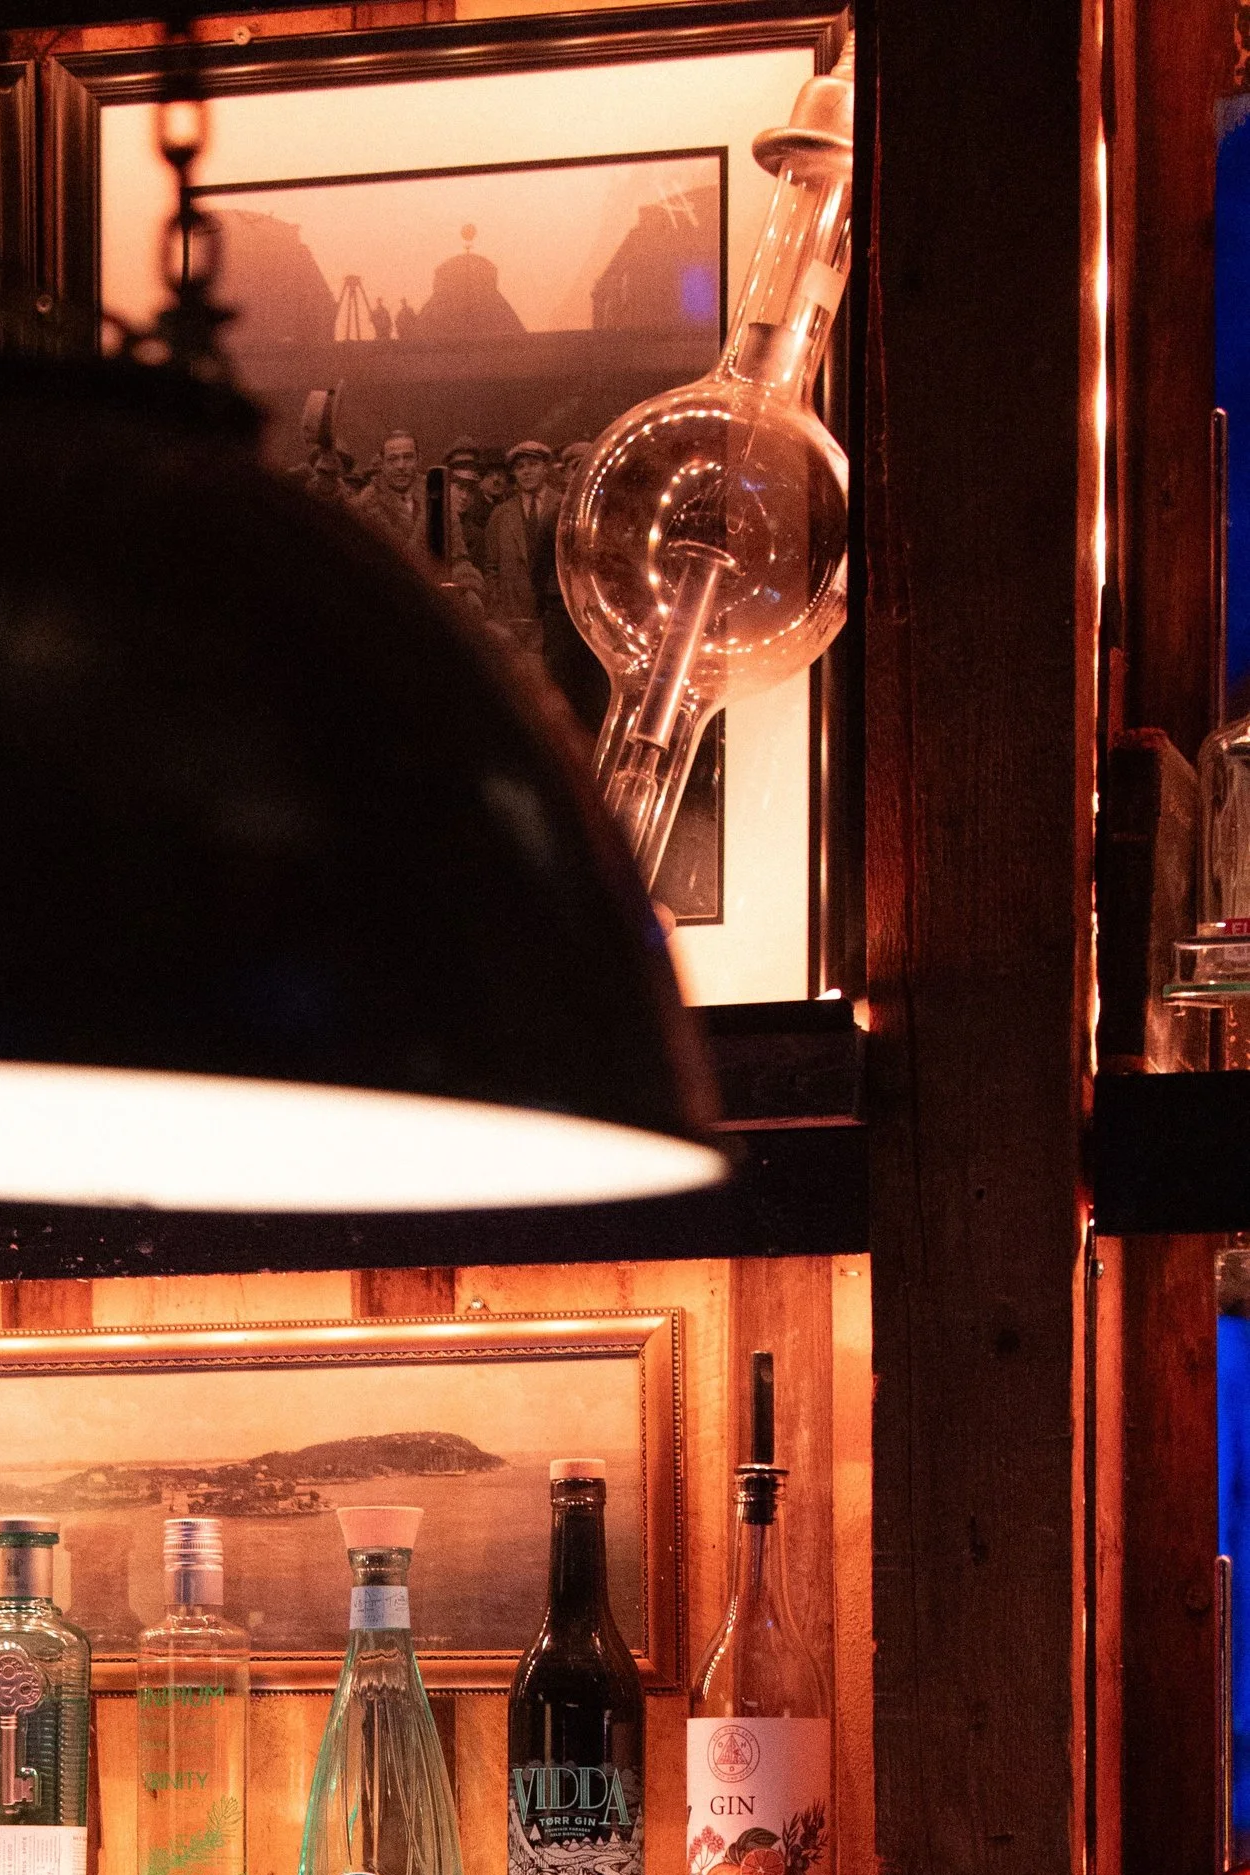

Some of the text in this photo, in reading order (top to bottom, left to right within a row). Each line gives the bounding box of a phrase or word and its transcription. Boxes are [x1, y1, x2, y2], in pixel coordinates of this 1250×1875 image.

[512, 1766, 632, 1826] VIDDA
[710, 1796, 756, 1815] GIN
[539, 1816, 596, 1828] TØRR GIN
